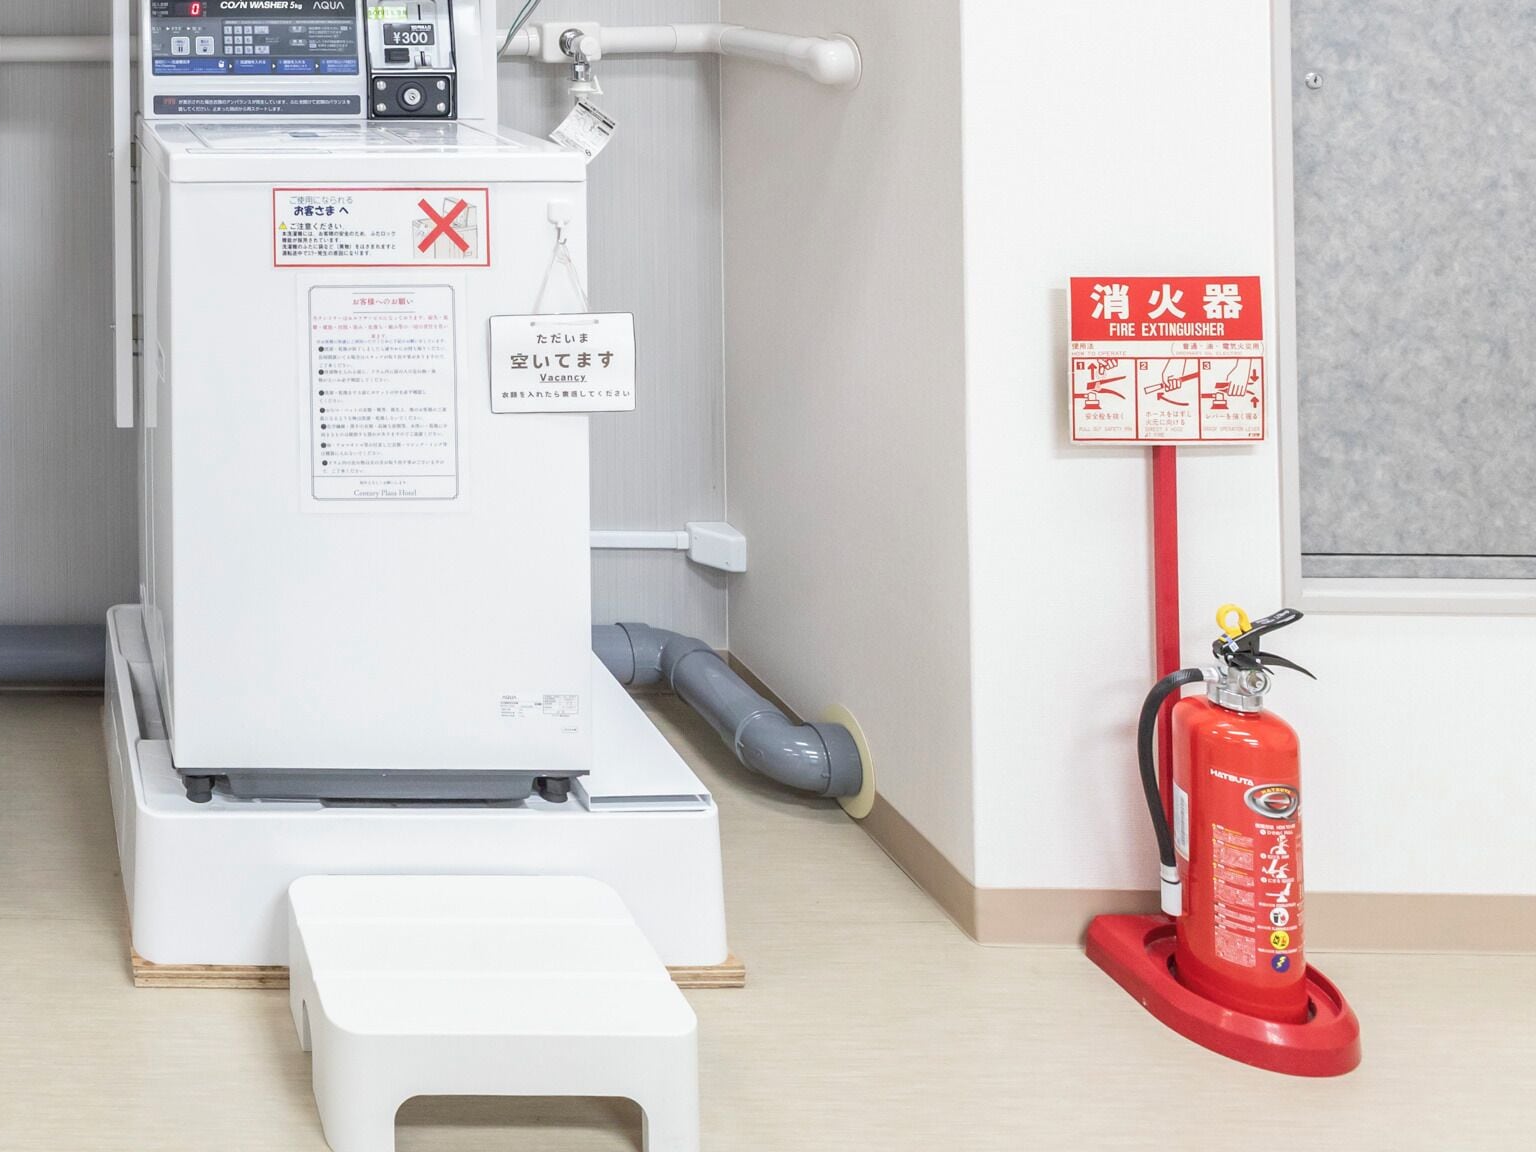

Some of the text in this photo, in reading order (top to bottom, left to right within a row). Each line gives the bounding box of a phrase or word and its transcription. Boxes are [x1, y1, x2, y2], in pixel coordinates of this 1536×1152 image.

[191, 3, 200, 15] 0
[249, 1, 289, 9] WASHER
[313, 1, 345, 10] AQUA
[393, 32, 428, 44] ¥300
[289, 196, 353, 205] ご使用になられる
[1090, 284, 1243, 320] 消火器
[1109, 322, 1225, 337] FIRE EXTINGUISHER
[536, 333, 588, 344] ただいま
[510, 351, 614, 369] 空いてます
[540, 373, 586, 383] Vacancy
[354, 489, 379, 497] Century
